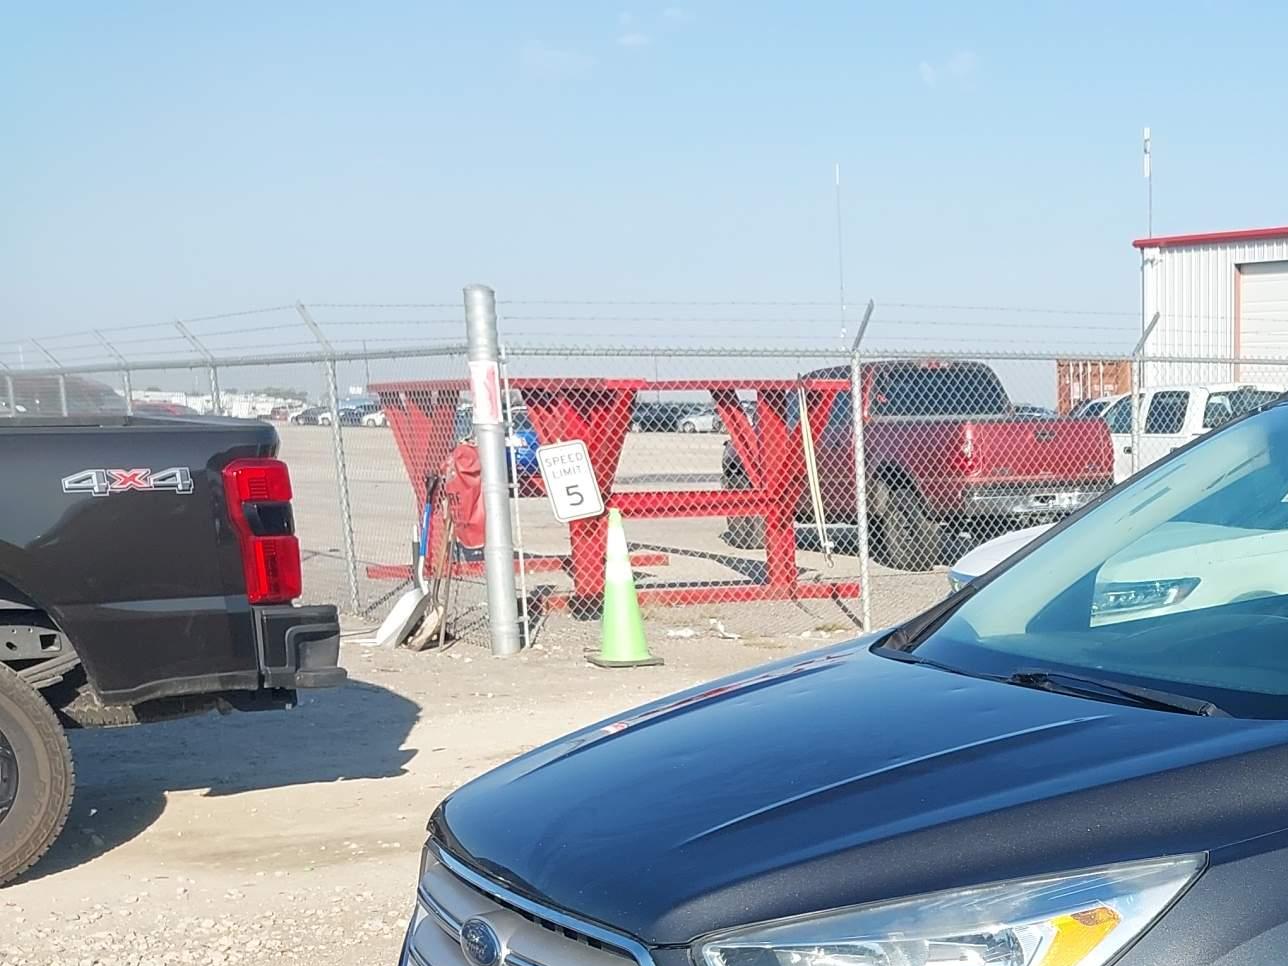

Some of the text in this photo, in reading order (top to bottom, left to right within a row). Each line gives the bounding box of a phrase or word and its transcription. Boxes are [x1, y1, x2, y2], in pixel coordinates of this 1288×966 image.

[544, 452, 583, 467] SPEED
[552, 465, 582, 479] LIMIT
[565, 484, 584, 506] 5
